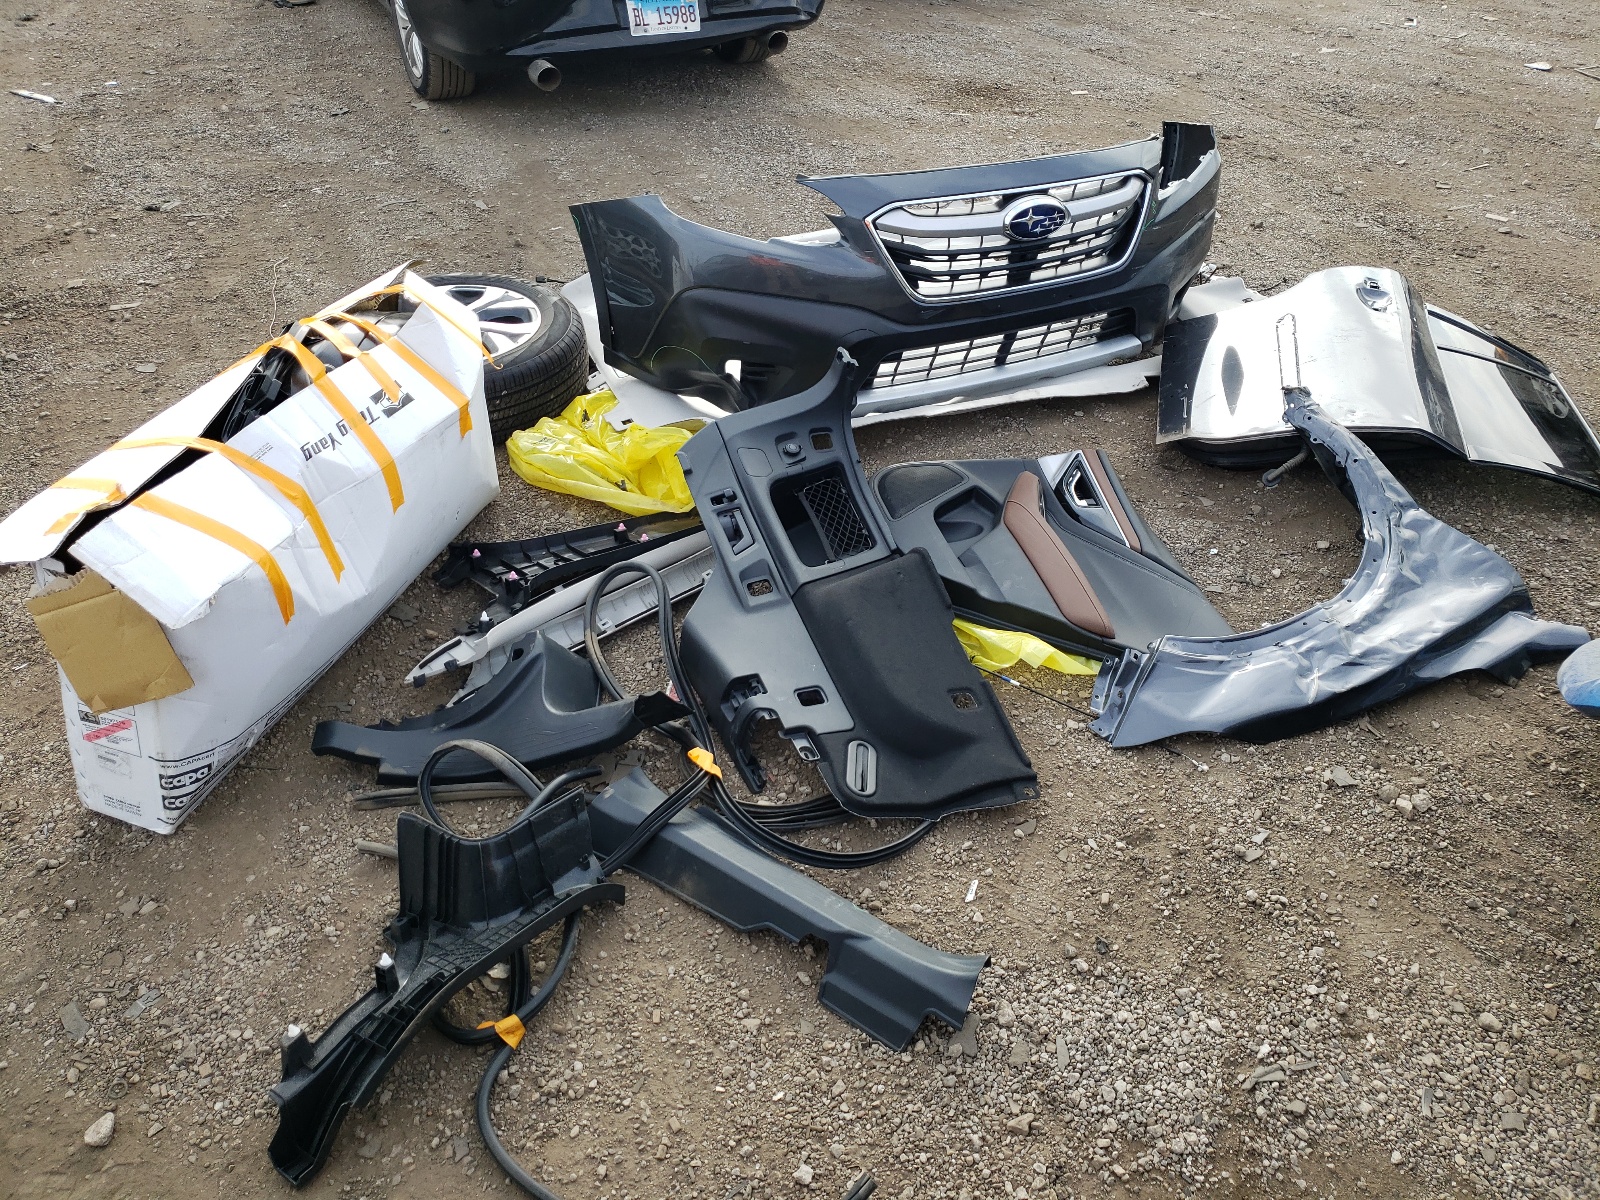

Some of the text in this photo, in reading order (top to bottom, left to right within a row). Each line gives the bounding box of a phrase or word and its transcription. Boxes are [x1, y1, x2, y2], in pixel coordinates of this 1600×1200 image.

[632, 5, 697, 27] BL 15988
[336, 406, 381, 437] Tg
[299, 433, 342, 462] Yang
[160, 766, 210, 788] capa
